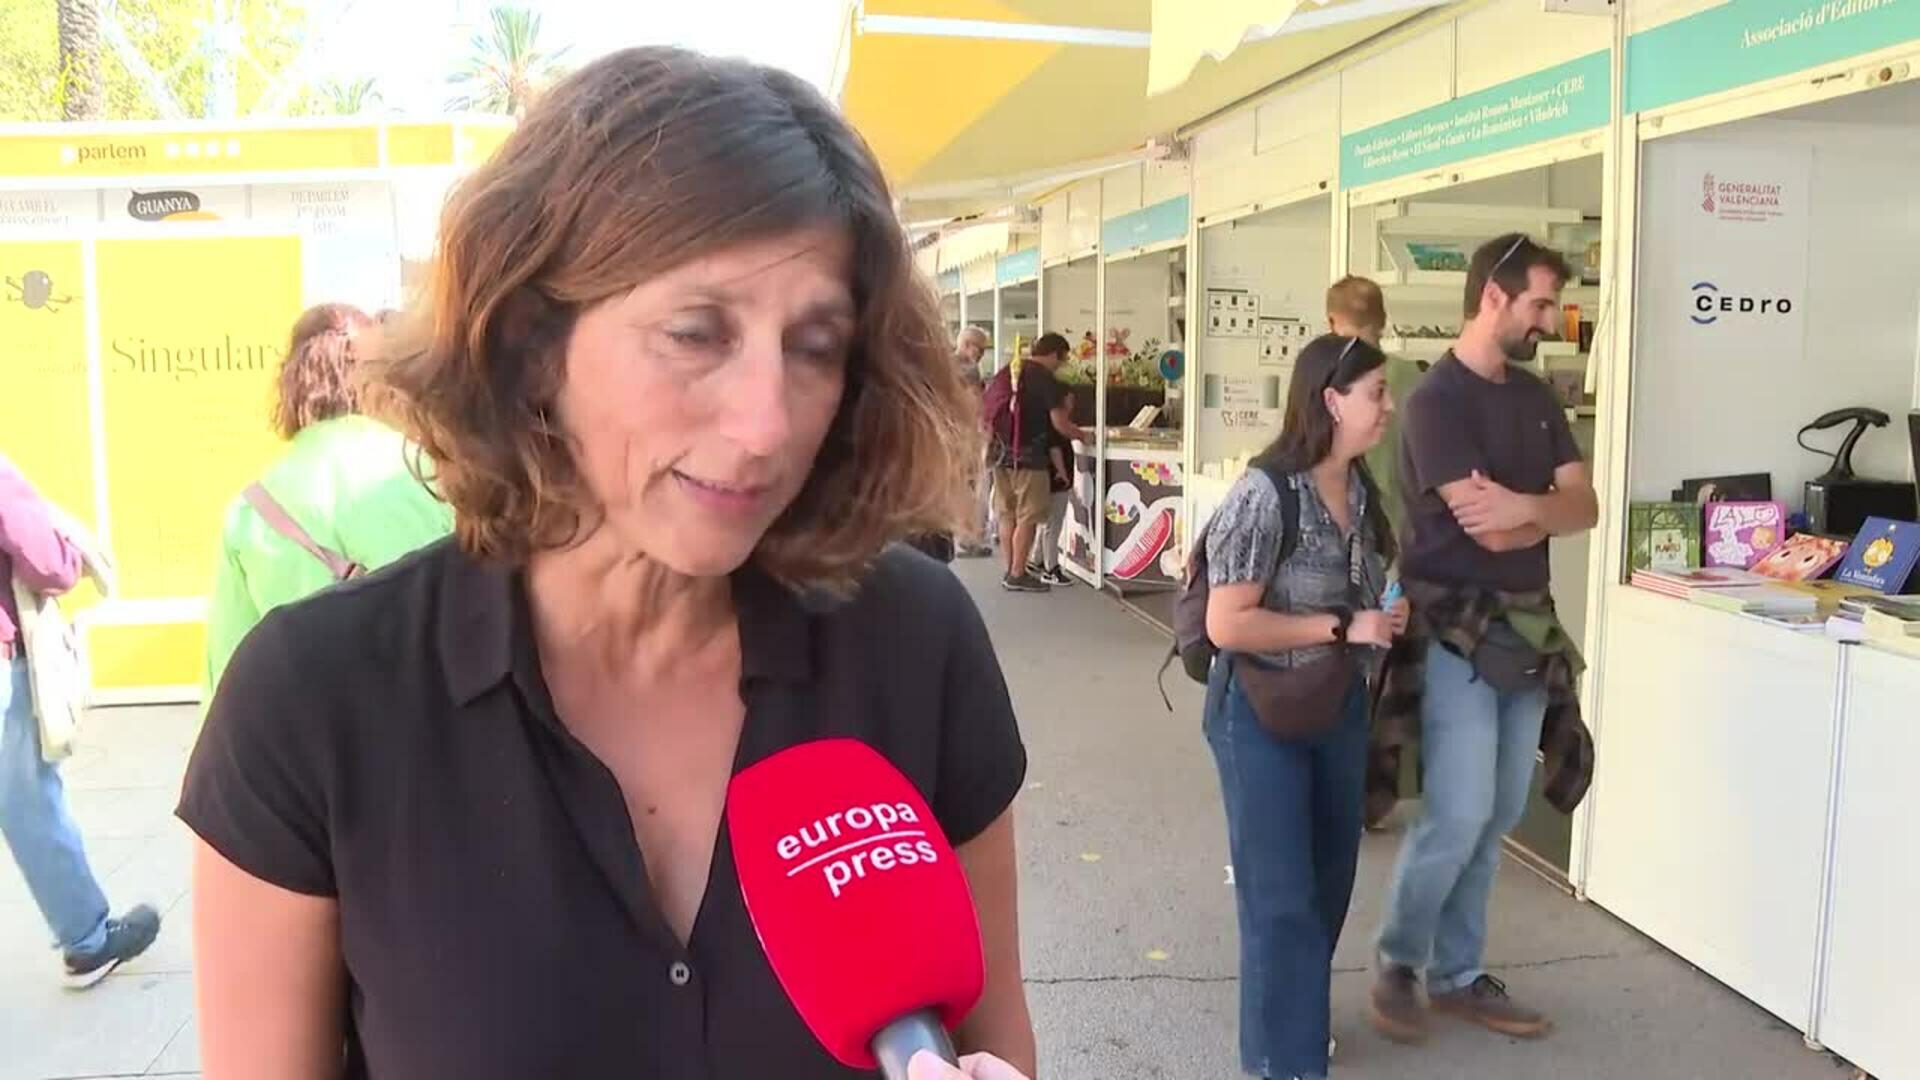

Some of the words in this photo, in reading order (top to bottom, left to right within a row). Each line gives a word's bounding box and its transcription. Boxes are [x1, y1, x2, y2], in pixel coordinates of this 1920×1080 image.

[77, 143, 147, 164] parlem
[1718, 182, 1781, 196] GENERALITAT
[136, 197, 192, 215] GUANYA
[1719, 194, 1779, 206] VALENCIANA
[776, 801, 920, 860] europa
[823, 840, 938, 898] press
